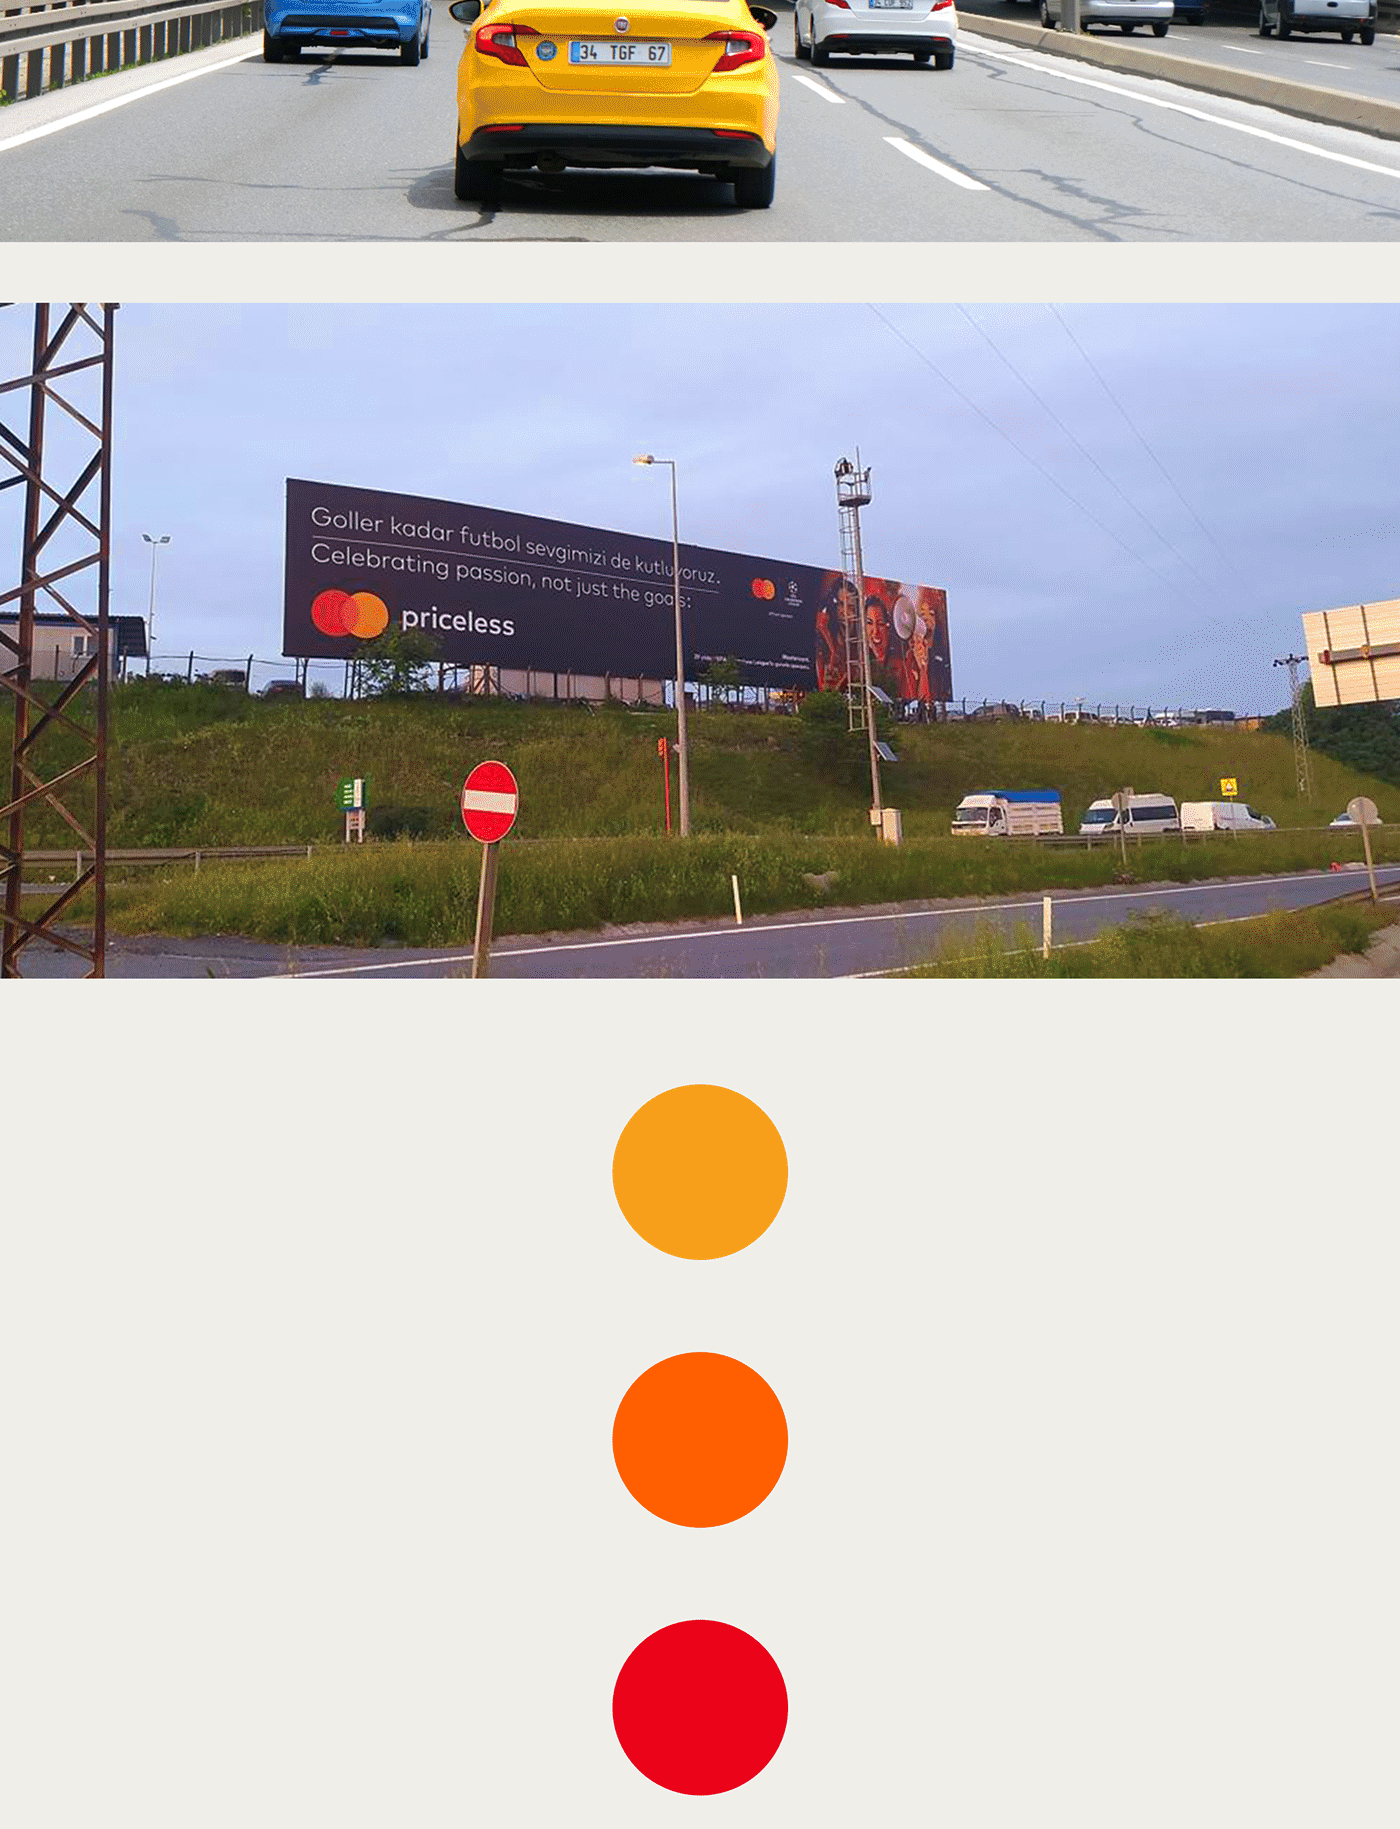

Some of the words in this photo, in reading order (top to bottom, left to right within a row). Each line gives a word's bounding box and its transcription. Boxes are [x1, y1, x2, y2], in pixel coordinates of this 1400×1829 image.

[580, 44, 597, 60] 34
[610, 45, 636, 61] TGF
[648, 46, 665, 61] 67
[311, 507, 383, 532] Goller
[391, 514, 454, 542] kadar
[461, 526, 520, 553] futbol
[526, 539, 606, 567] sevgimizi
[610, 553, 631, 571] de
[311, 543, 449, 580] Celebrating
[456, 562, 536, 590] passion,
[542, 574, 571, 592] not
[576, 578, 608, 600] just
[613, 583, 640, 603] the
[402, 607, 515, 636] priceless
